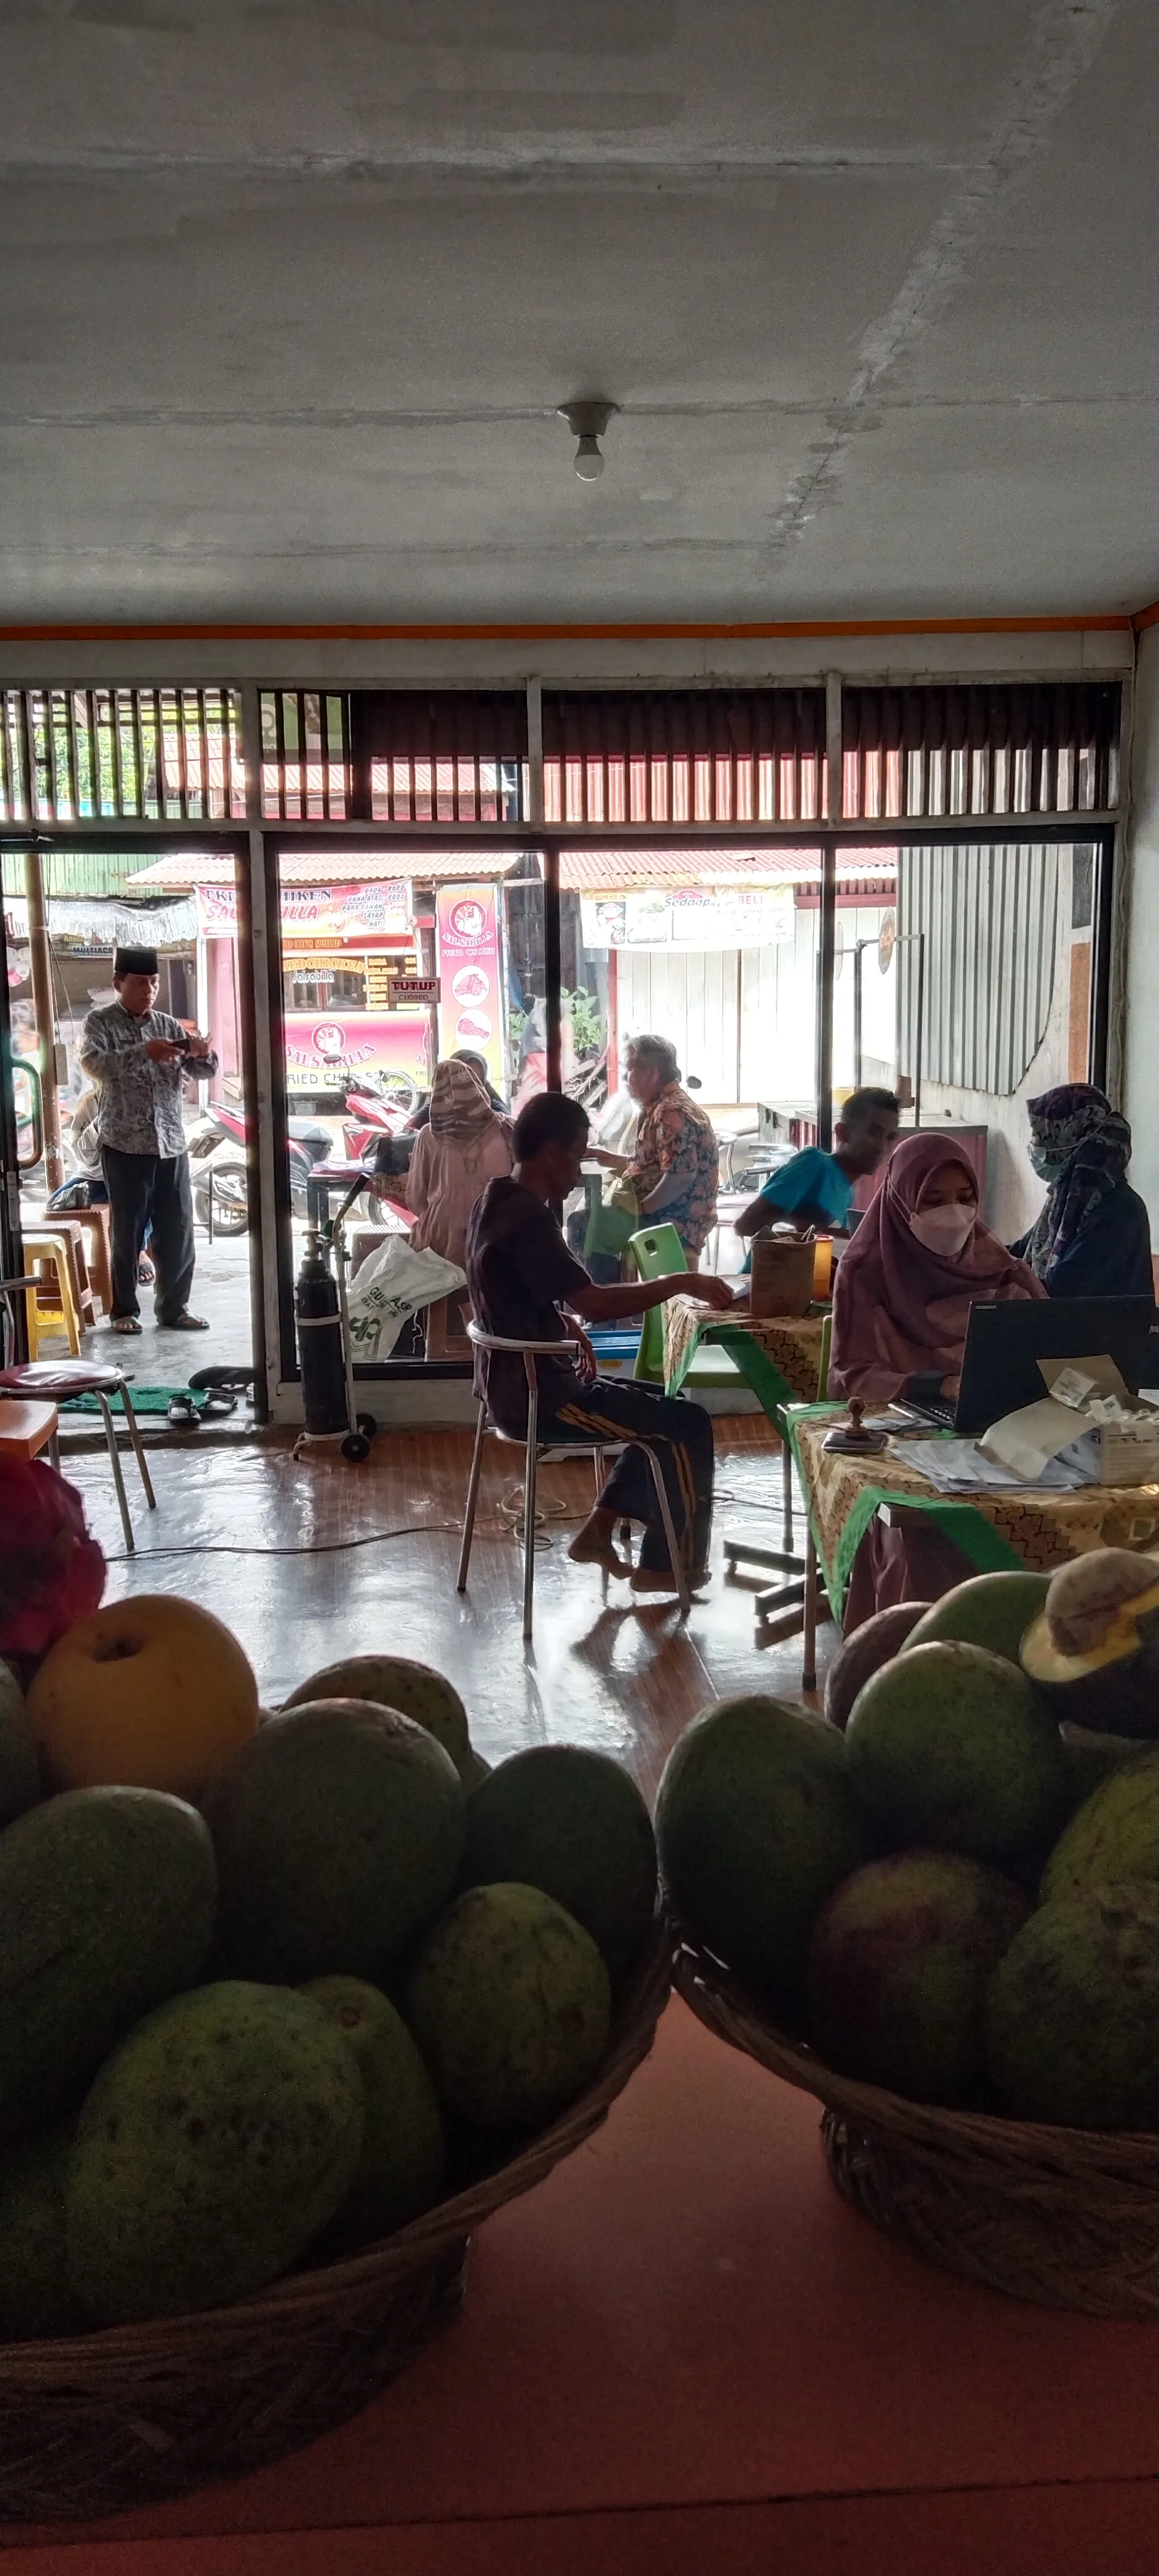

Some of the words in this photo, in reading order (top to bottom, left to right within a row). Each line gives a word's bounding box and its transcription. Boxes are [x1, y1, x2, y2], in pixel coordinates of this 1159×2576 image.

[280, 890, 331, 902] HIKEN
[391, 981, 436, 991] TUTUP
[287, 1073, 318, 1084] RIED
